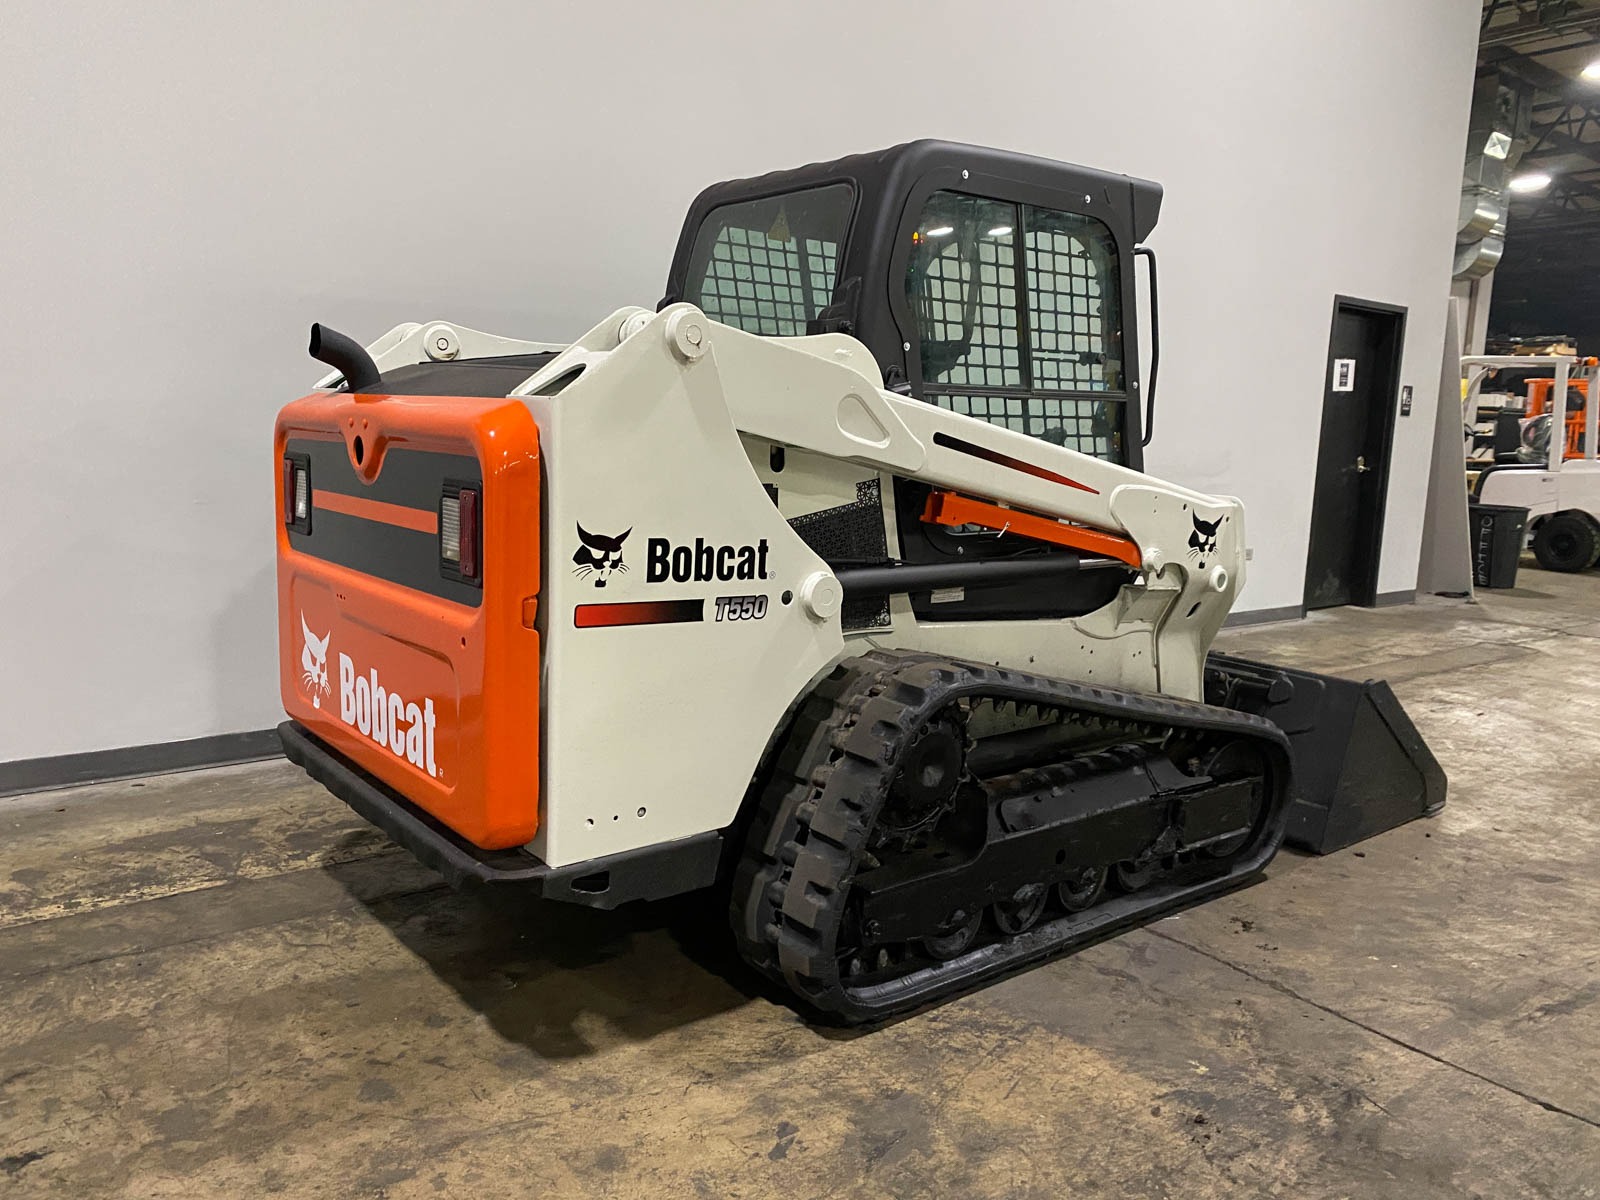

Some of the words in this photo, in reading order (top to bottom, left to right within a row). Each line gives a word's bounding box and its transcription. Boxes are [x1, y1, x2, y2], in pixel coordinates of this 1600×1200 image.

[646, 537, 769, 583] Bobcat
[715, 594, 768, 622] T550
[339, 652, 437, 777] Bobcat
